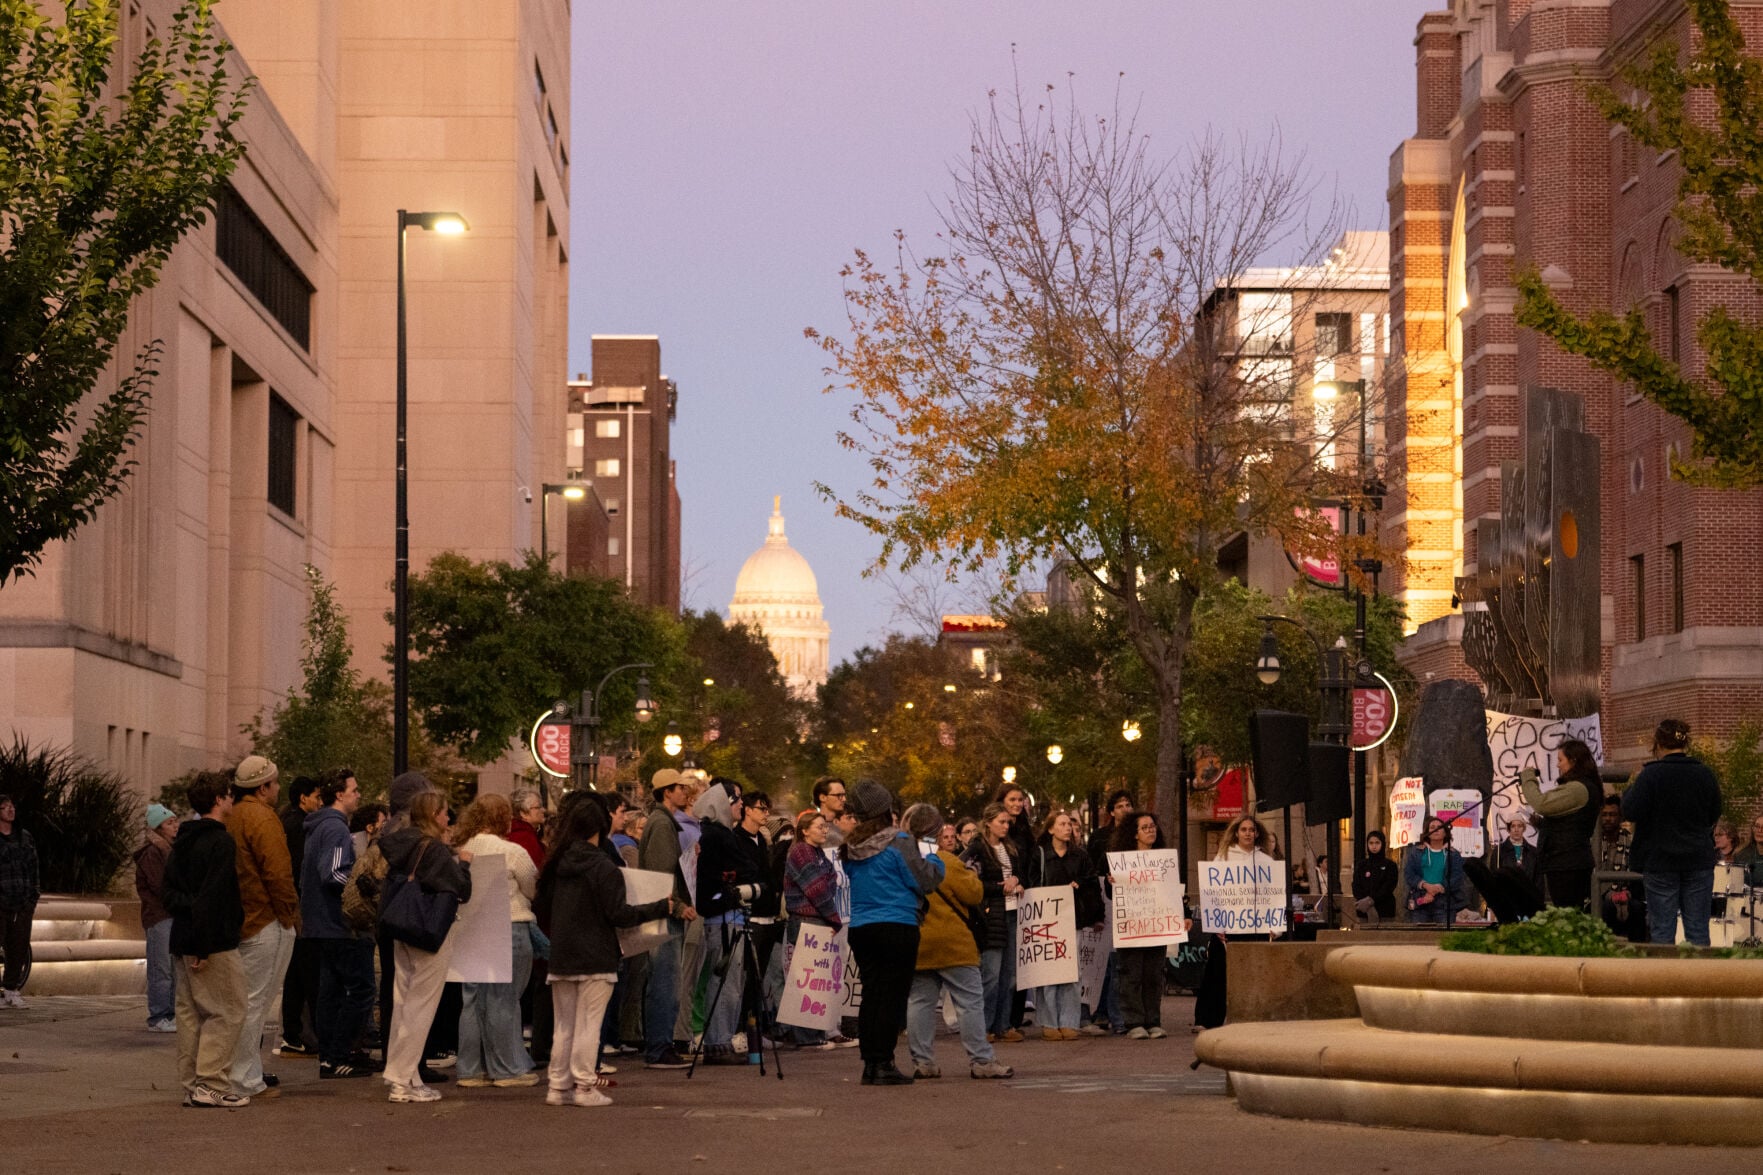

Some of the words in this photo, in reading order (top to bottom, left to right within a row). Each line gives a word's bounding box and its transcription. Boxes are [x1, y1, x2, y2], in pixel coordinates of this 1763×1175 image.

[1354, 697, 1364, 736] BLOCK
[1365, 689, 1385, 736] 700
[1405, 780, 1422, 789] NOT
[1443, 801, 1468, 810] RAPE
[1107, 852, 1141, 871] What
[1129, 868, 1168, 885] RAPE?
[1208, 865, 1272, 886] RAINN
[1019, 898, 1064, 925] DON'T
[1022, 923, 1057, 945] GET
[1128, 915, 1182, 936] RAPISTS
[804, 932, 818, 949] We
[813, 959, 830, 969] with
[796, 968, 832, 991] Jane
[800, 994, 827, 1016] Doe
